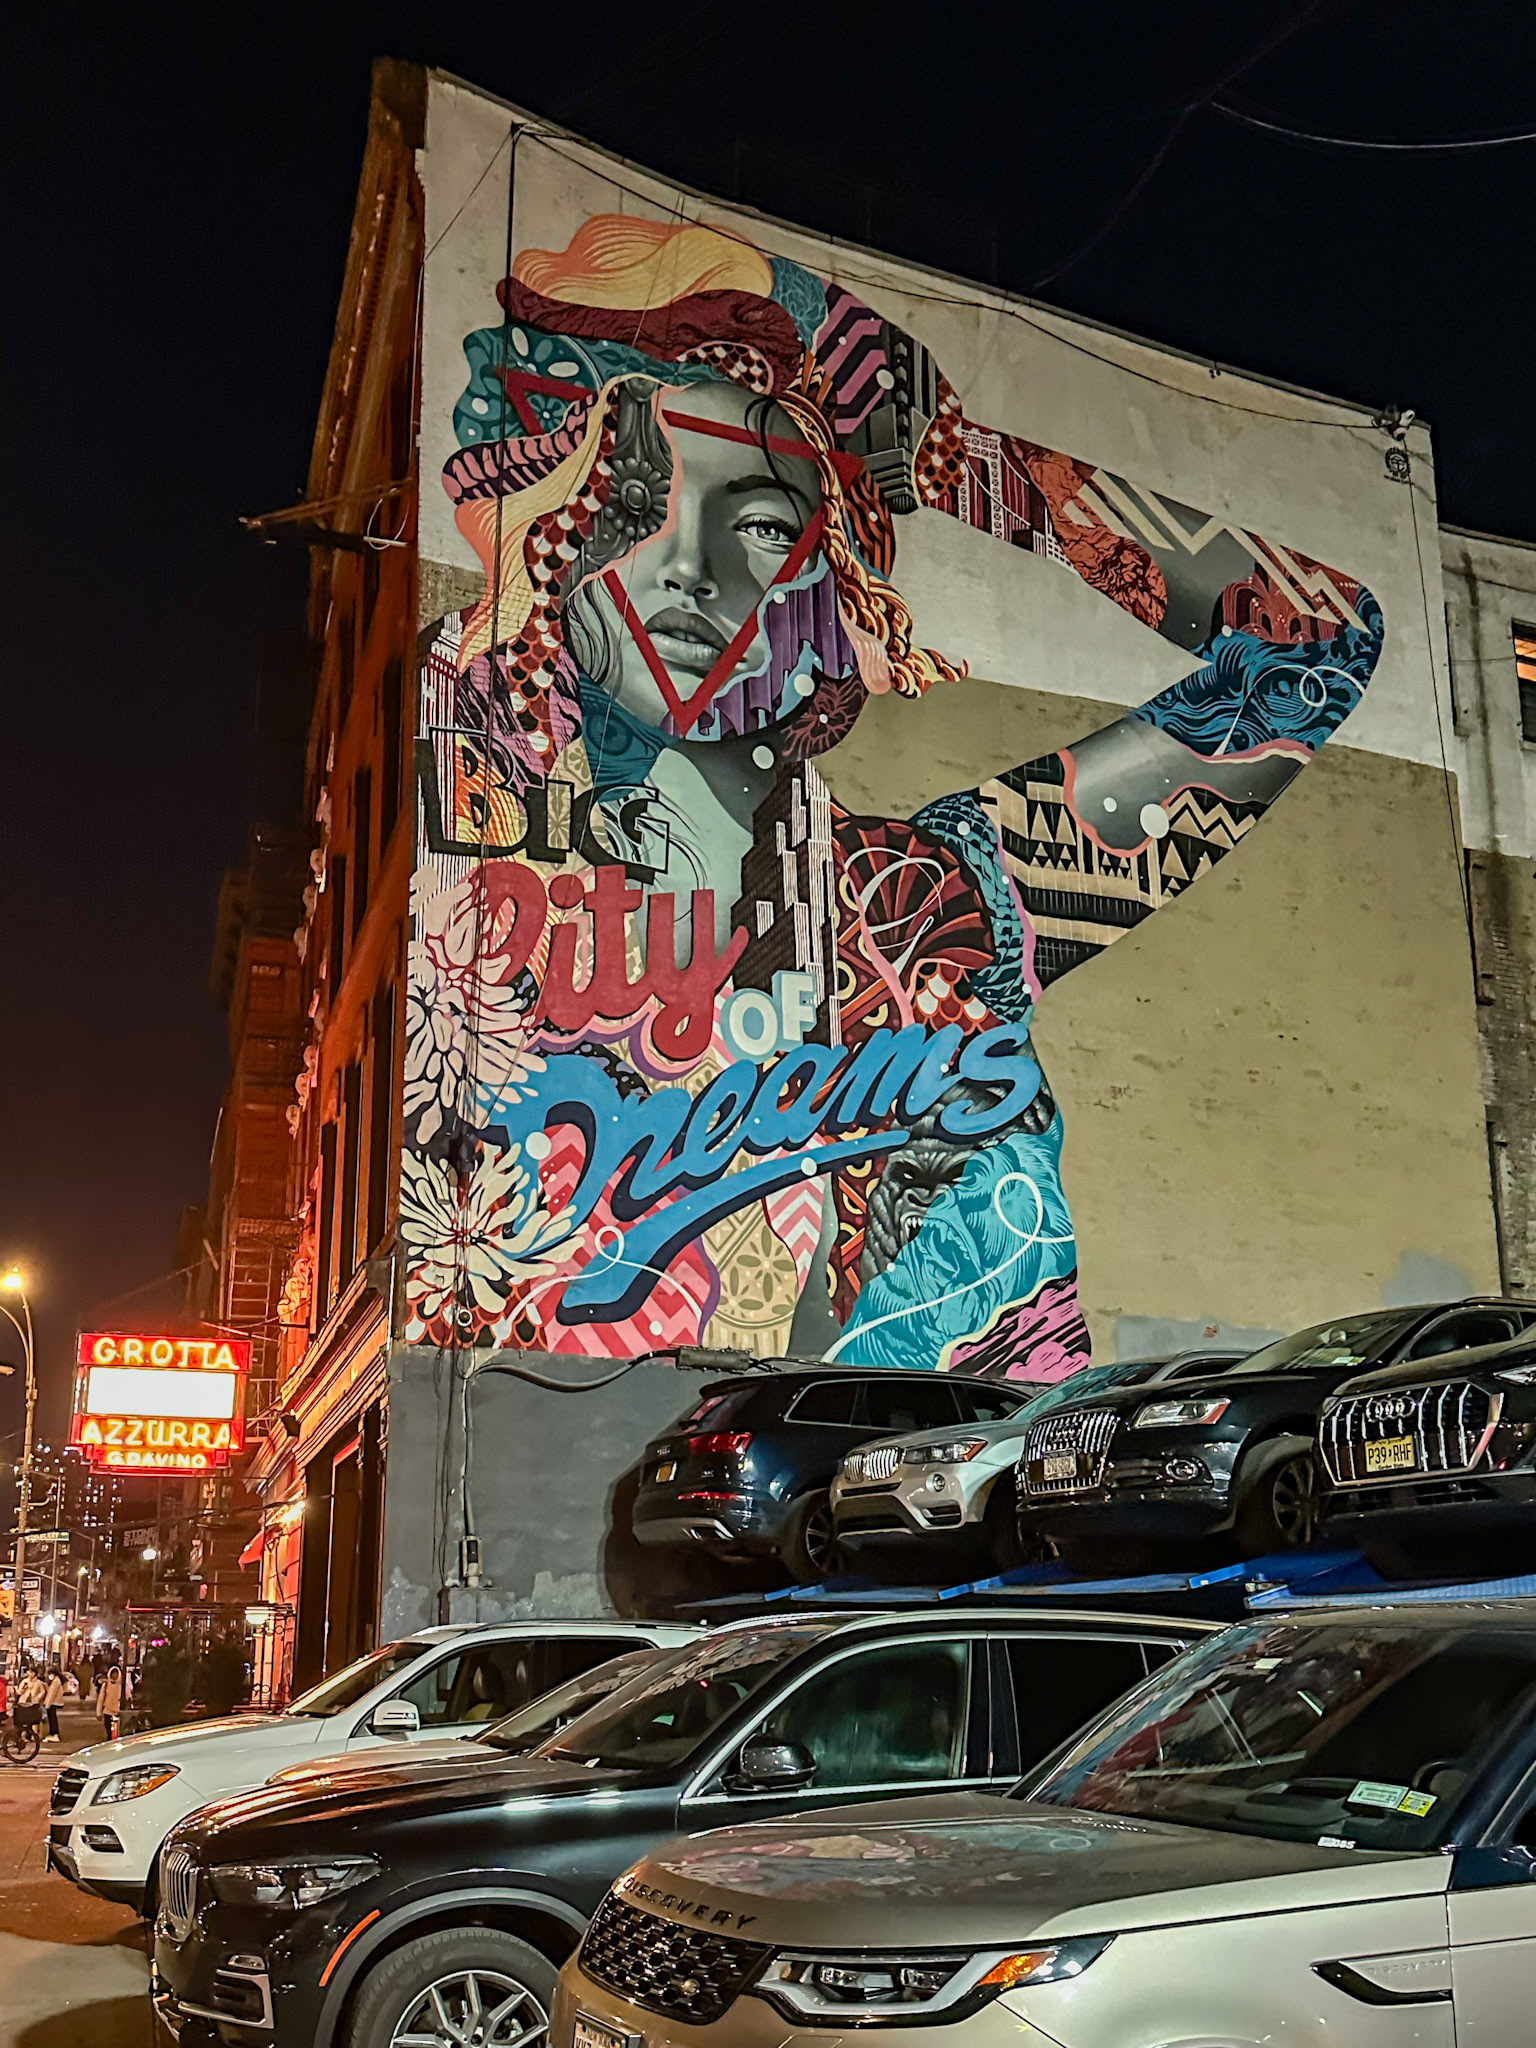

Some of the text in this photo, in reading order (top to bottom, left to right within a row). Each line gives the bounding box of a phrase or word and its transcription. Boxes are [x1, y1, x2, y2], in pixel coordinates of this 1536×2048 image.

[413, 724, 670, 886] BIG
[720, 969, 817, 1064] OF
[94, 1337, 239, 1370] GROTTA
[75, 1419, 239, 1449] AZZURRA
[624, 1876, 757, 1930] DISCOVERY
